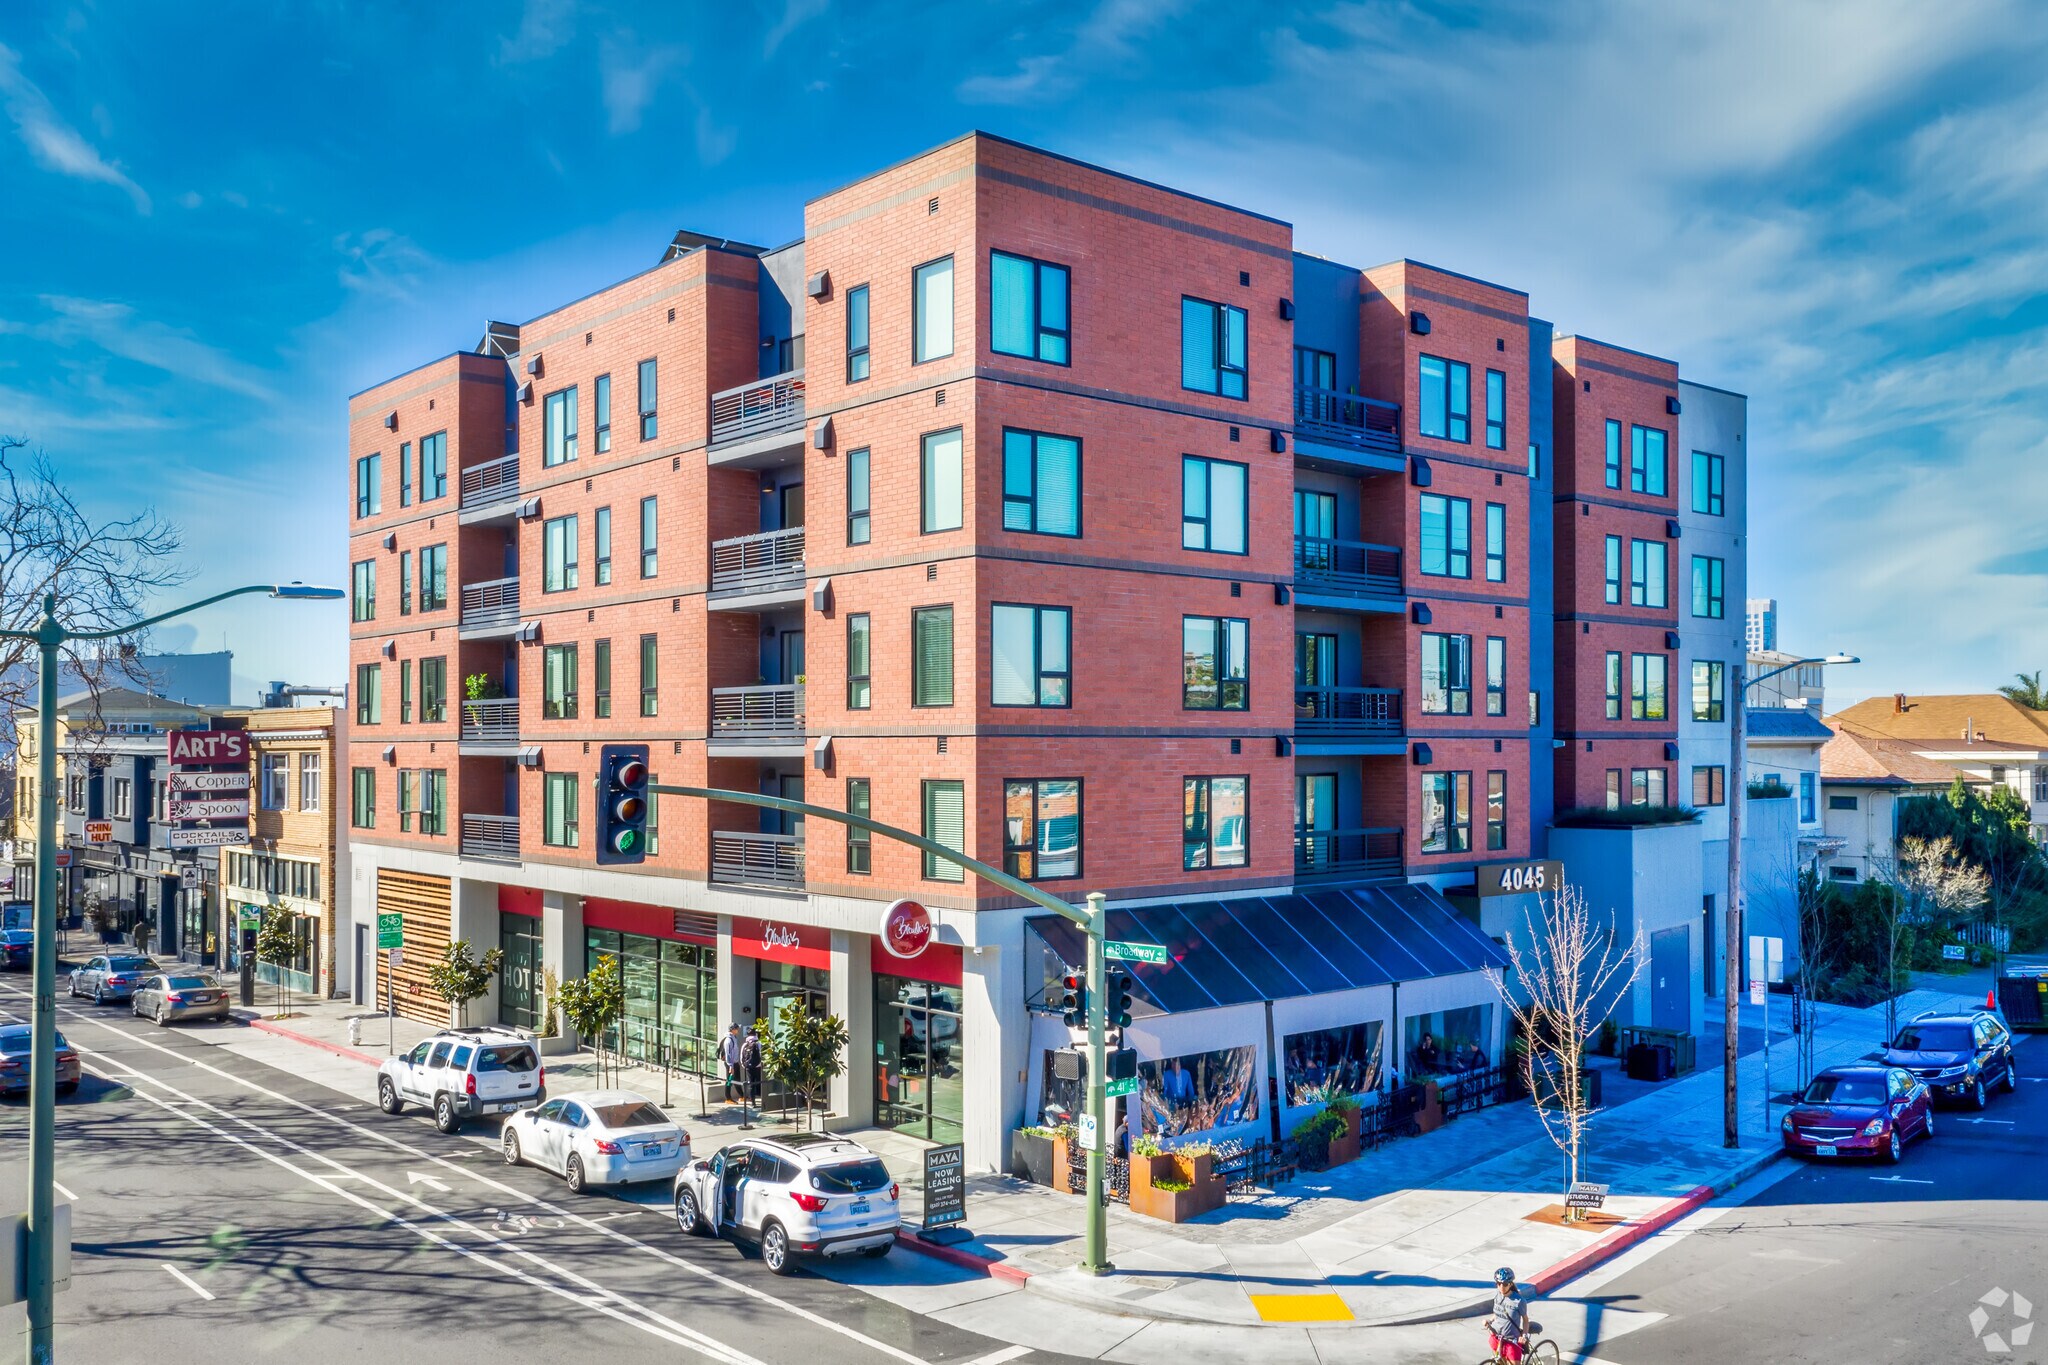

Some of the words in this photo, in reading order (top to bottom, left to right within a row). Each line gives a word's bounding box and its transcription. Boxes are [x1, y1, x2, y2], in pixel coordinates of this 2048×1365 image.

[173, 732, 242, 758] ART'S
[91, 833, 112, 842] HUT
[173, 831, 235, 840] COCKTAILS
[233, 832, 245, 842] &
[186, 837, 234, 845] KITCHEN
[1500, 866, 1545, 891] 4045
[1114, 944, 1155, 961] Broadway
[504, 964, 531, 990] HOT
[930, 1152, 959, 1166] MAYA
[934, 1168, 954, 1178] NOW
[928, 1175, 961, 1189] LEASING
